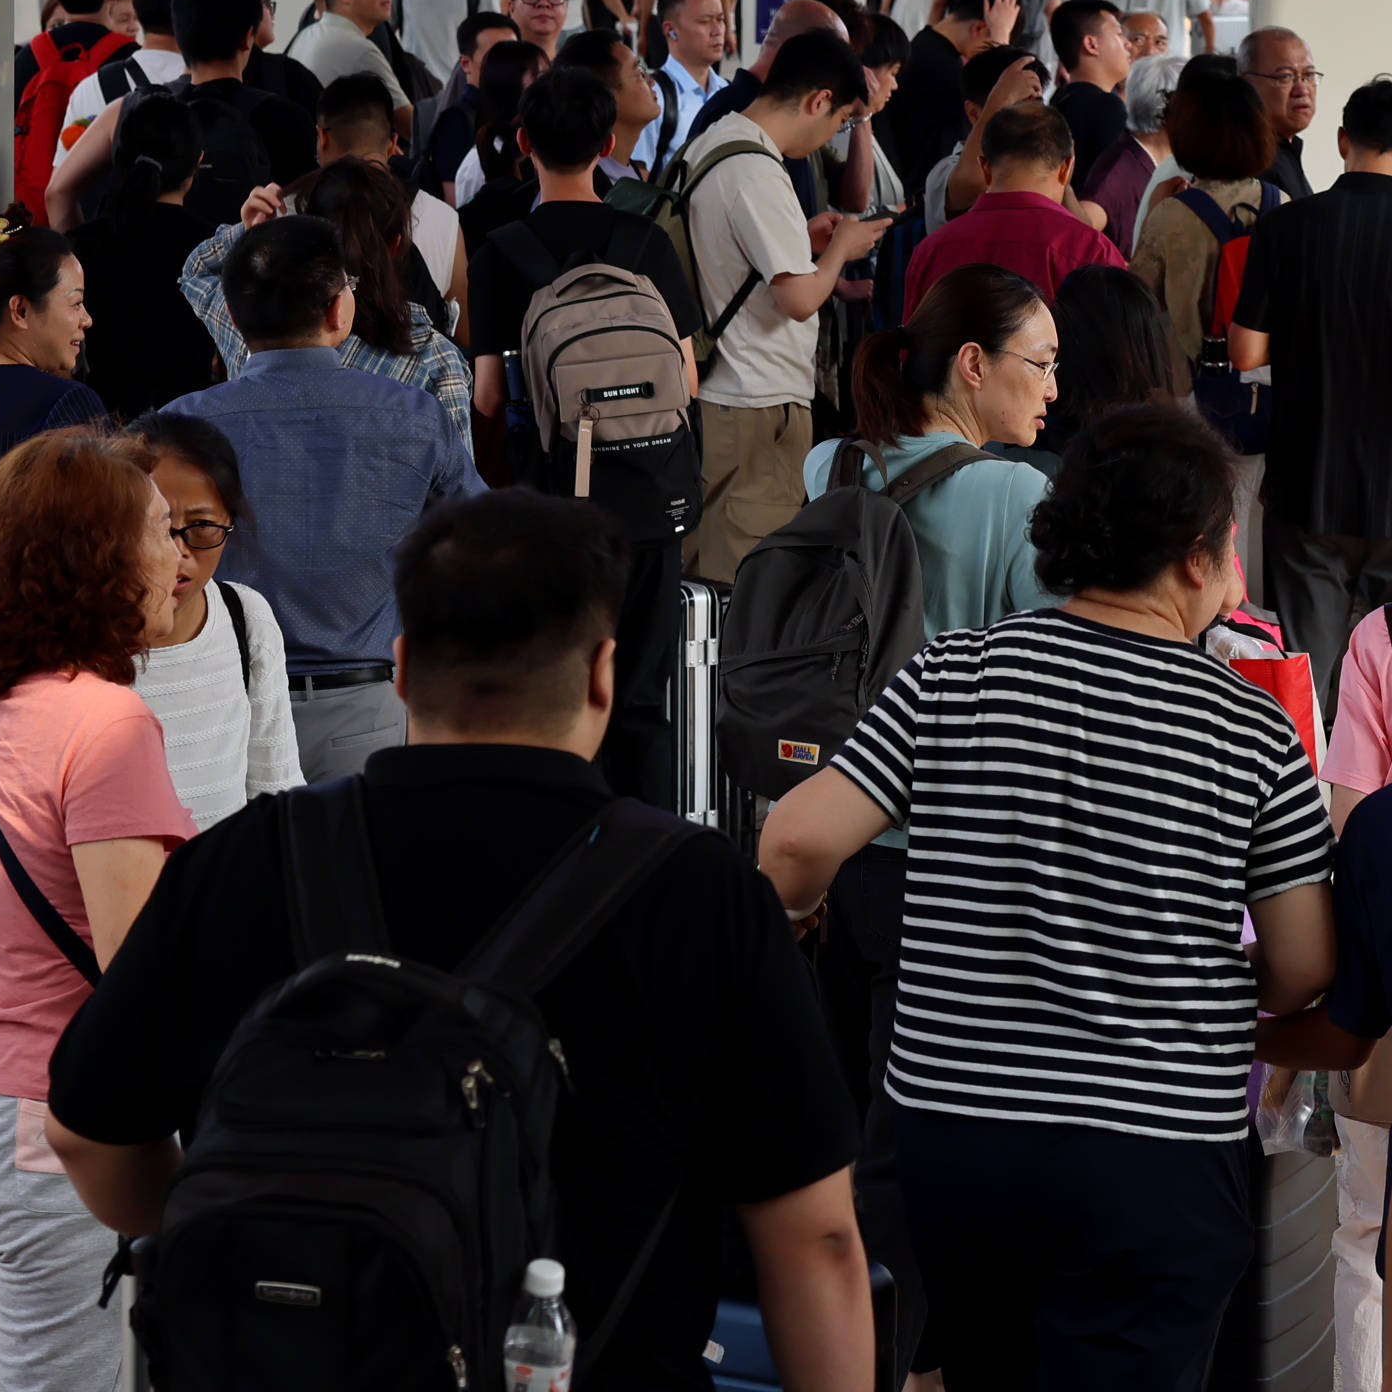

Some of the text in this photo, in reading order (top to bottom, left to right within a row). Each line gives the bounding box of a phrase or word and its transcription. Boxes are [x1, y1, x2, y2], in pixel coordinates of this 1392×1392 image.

[603, 387, 640, 398] SUN EIGHT
[633, 441, 649, 449] YOUR
[651, 437, 672, 446] DREAM
